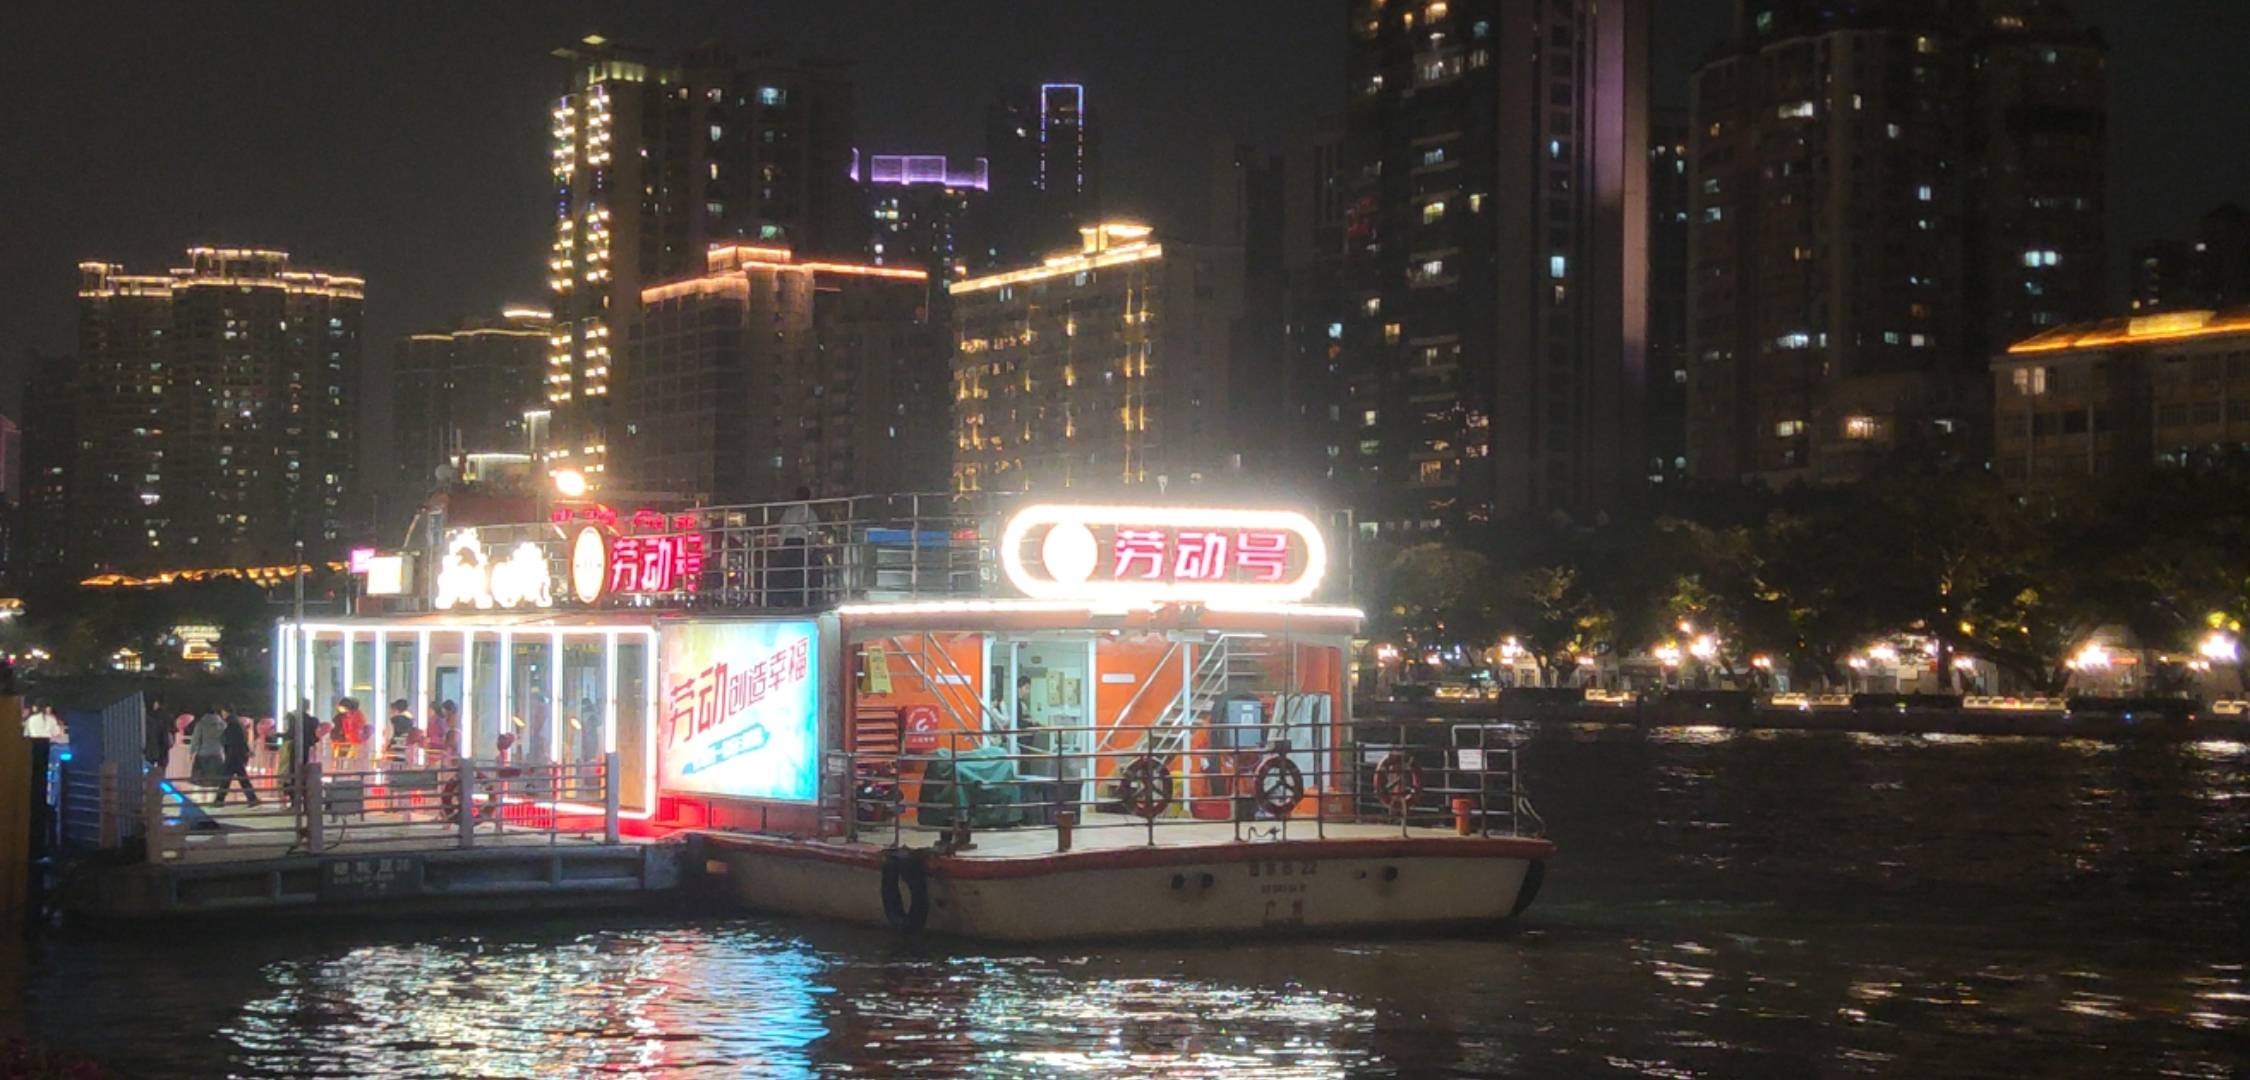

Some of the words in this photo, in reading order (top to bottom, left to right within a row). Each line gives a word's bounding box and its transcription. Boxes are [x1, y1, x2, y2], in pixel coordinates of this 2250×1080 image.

[1115, 530, 1289, 580] 劳动号
[668, 637, 808, 749] 劳动创造幸福
